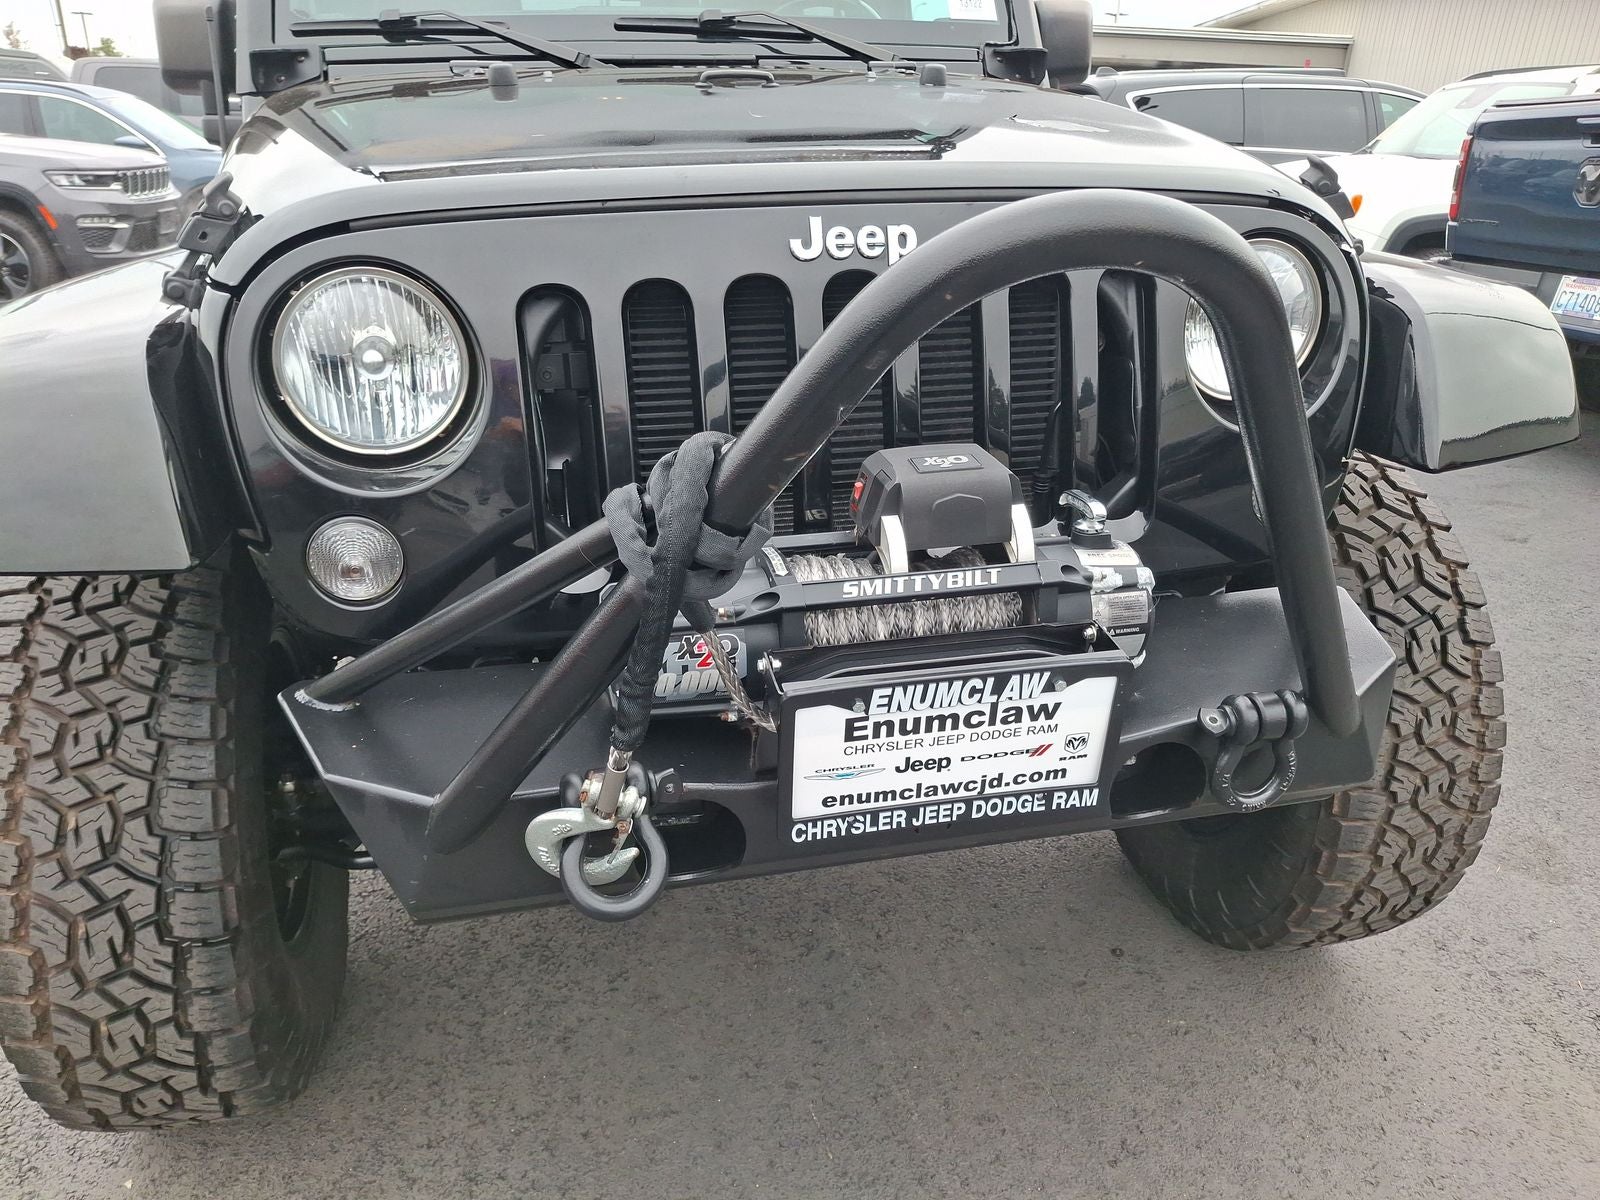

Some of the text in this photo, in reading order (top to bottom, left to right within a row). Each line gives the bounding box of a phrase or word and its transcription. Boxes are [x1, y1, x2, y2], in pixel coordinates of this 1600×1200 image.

[789, 216, 918, 266] Jeep
[842, 567, 1003, 599] SMITTYBILT
[868, 672, 1051, 715] ENUMCLAW
[844, 700, 1063, 743] Enumclaw
[843, 723, 1059, 757] CHRYSLER JEEP DODGE RAM
[960, 748, 1037, 763] DODGE
[815, 763, 875, 774] CHRYSLER
[895, 753, 952, 774] Jeep
[1059, 753, 1088, 762] RAM
[821, 765, 1068, 809] enumclawcjd.com
[791, 788, 1099, 844] CHRYSLER JEEP DODGE RAM
